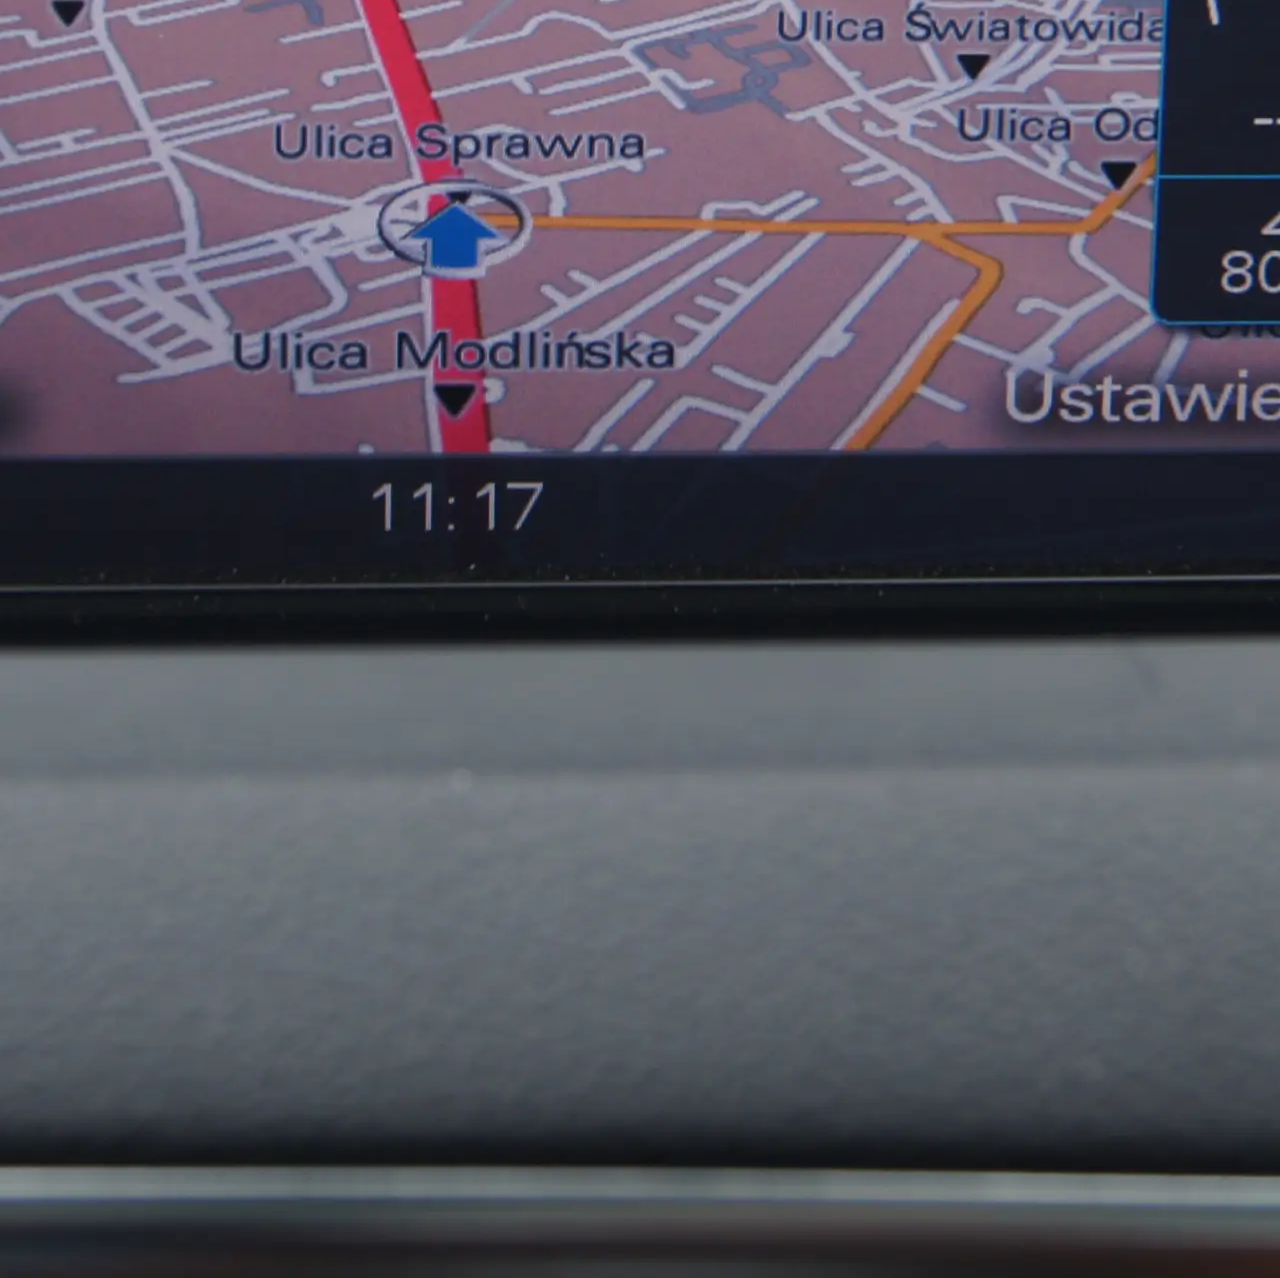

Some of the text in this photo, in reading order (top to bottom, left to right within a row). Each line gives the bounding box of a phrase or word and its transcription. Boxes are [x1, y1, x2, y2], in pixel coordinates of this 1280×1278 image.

[776, 1, 1164, 43] Ulica Światowida
[274, 124, 646, 166] Ulica Sprawna
[958, 107, 1160, 143] Ulica Od
[232, 330, 676, 372] Ulica Modlińska
[371, 481, 544, 531] 11:17
